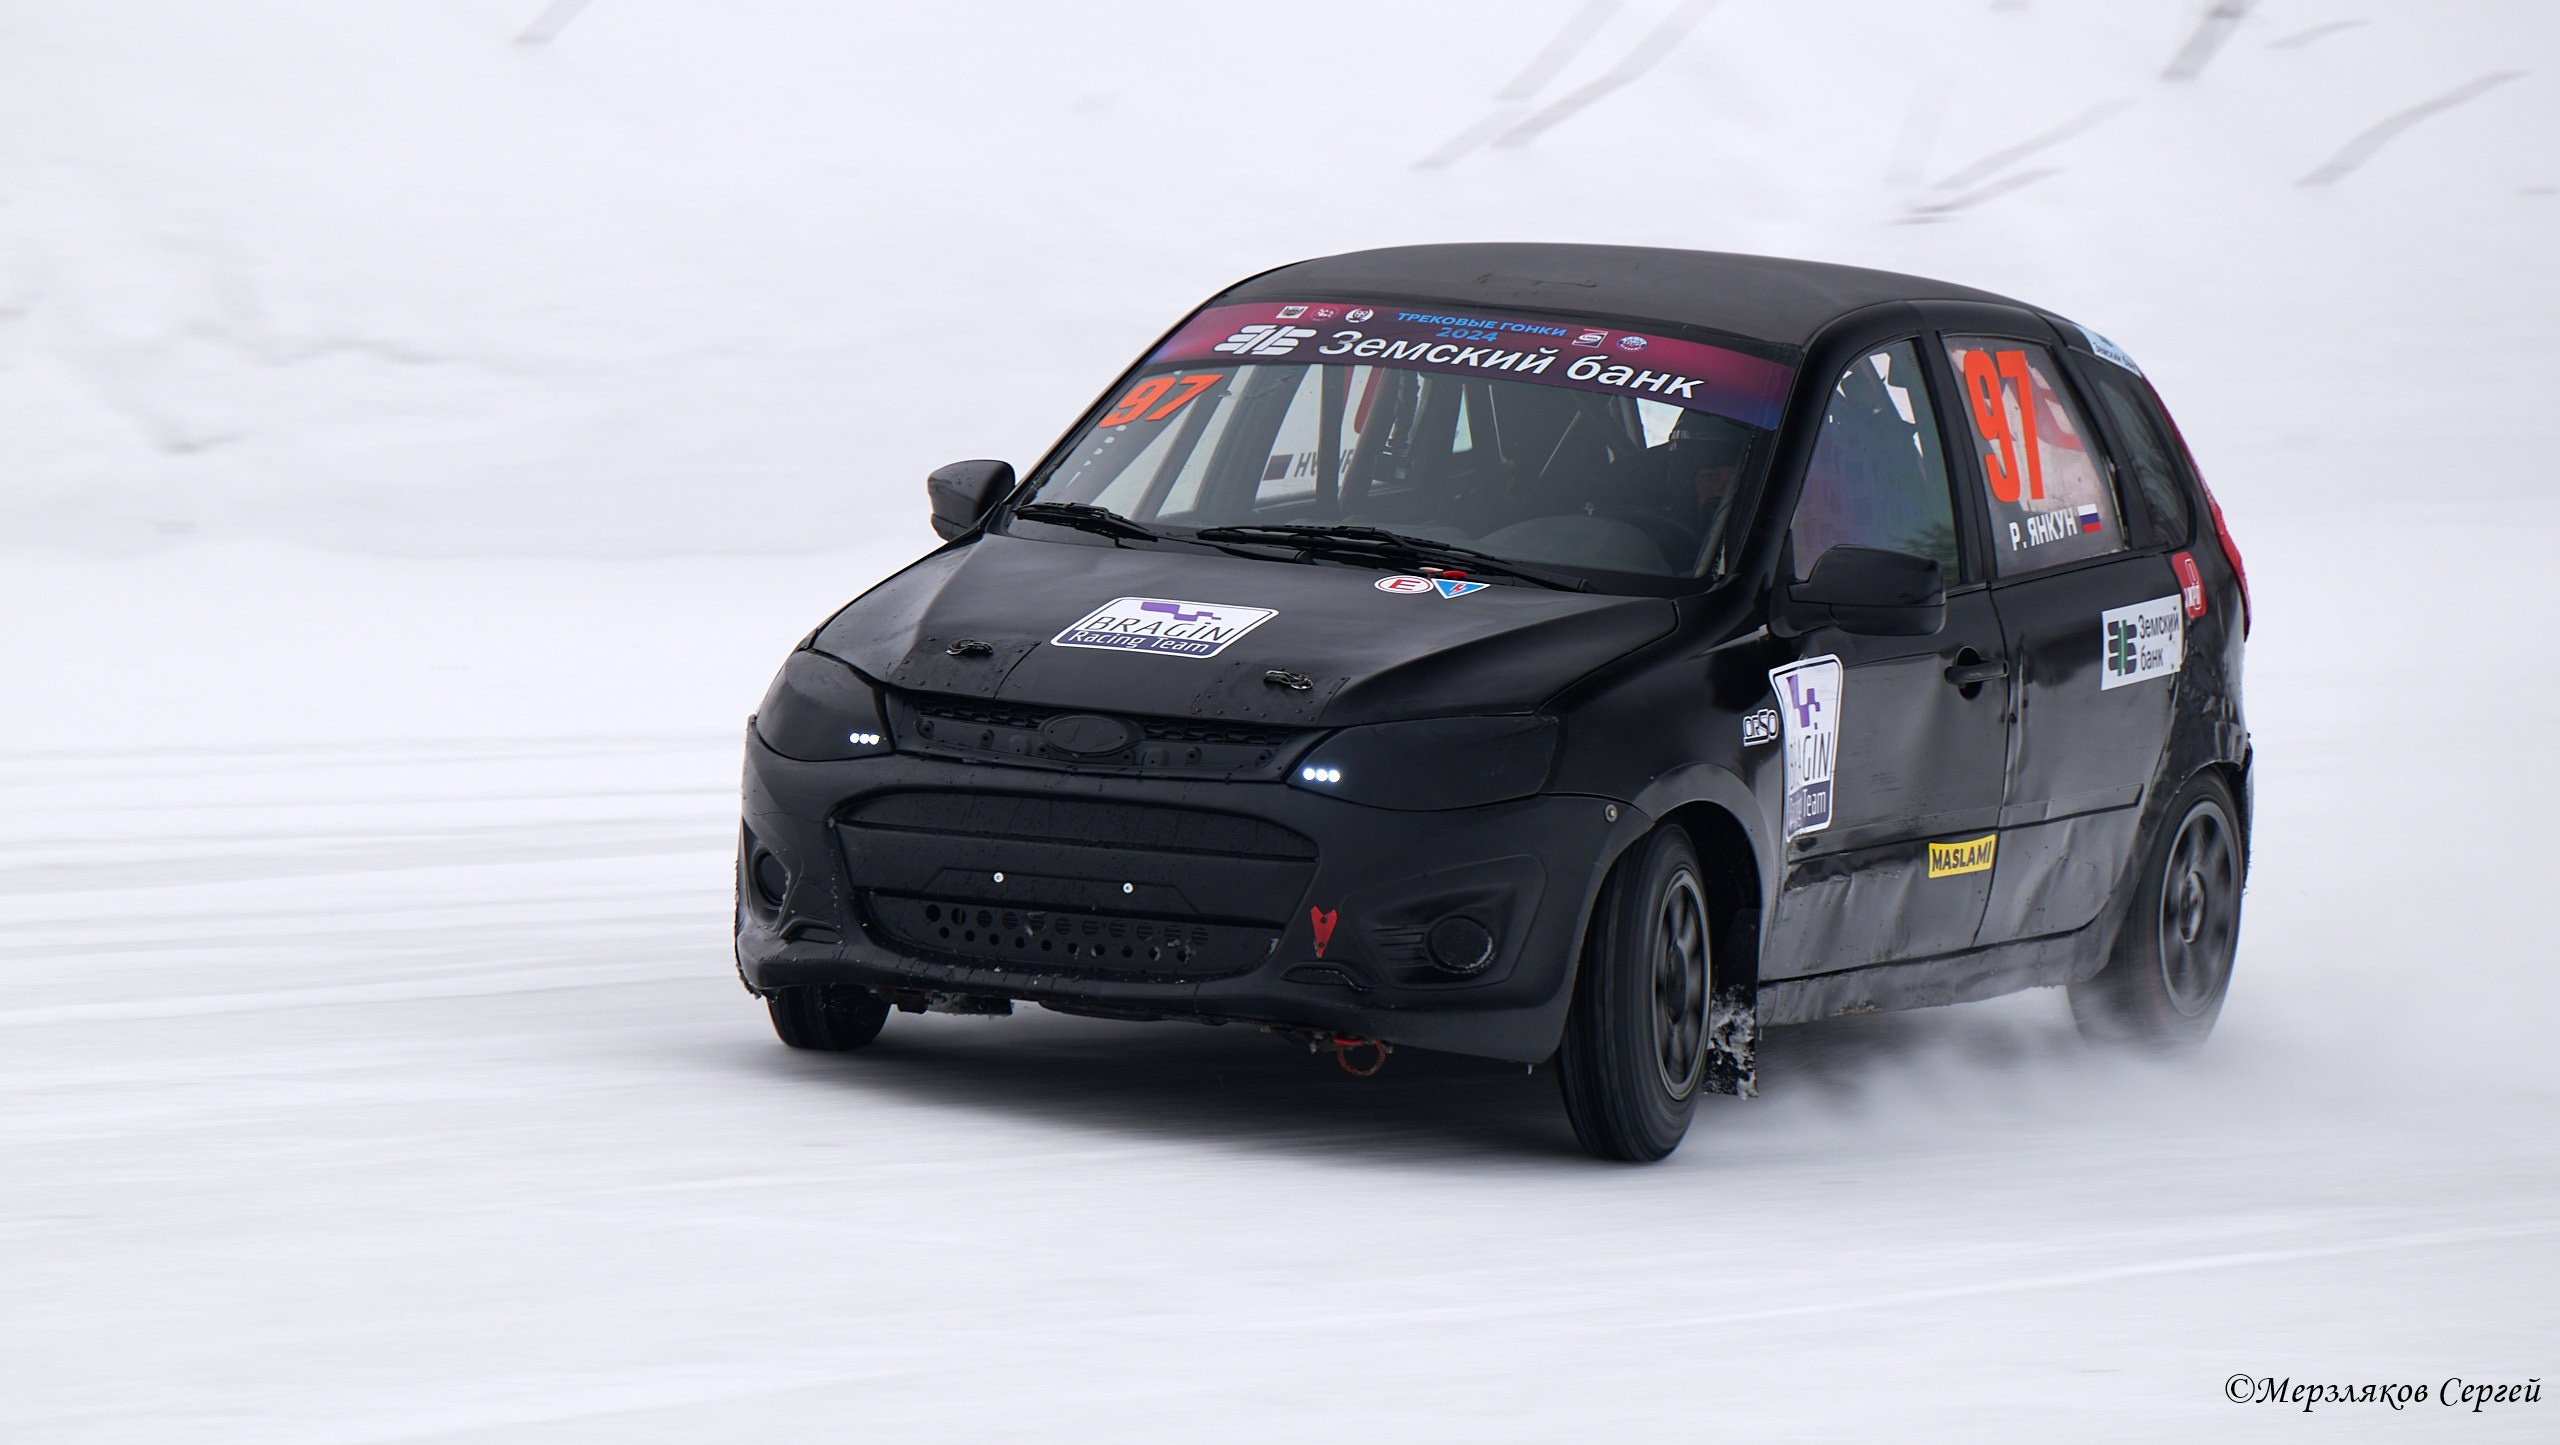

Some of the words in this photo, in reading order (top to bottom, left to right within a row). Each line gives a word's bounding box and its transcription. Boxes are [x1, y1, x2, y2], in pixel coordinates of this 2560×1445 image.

[1397, 312, 1498, 330] ТРЕКОВЫЕ
[1499, 322, 1568, 337] ГОНКИ
[1436, 326, 1499, 342] 2024
[1318, 330, 1558, 376] Земский
[1565, 353, 1705, 400] банк
[1100, 374, 1223, 429] 97
[1963, 350, 2045, 503] 97
[2009, 522, 2028, 551] Р.
[2030, 507, 2078, 547] ЯНКУН
[2138, 606, 2180, 640] Земский
[1068, 631, 1146, 649] Racing
[1151, 637, 1210, 653] Team
[2140, 645, 2164, 671] банк
[1803, 789, 1826, 817] Team
[1931, 841, 1992, 872] MASLAMI
